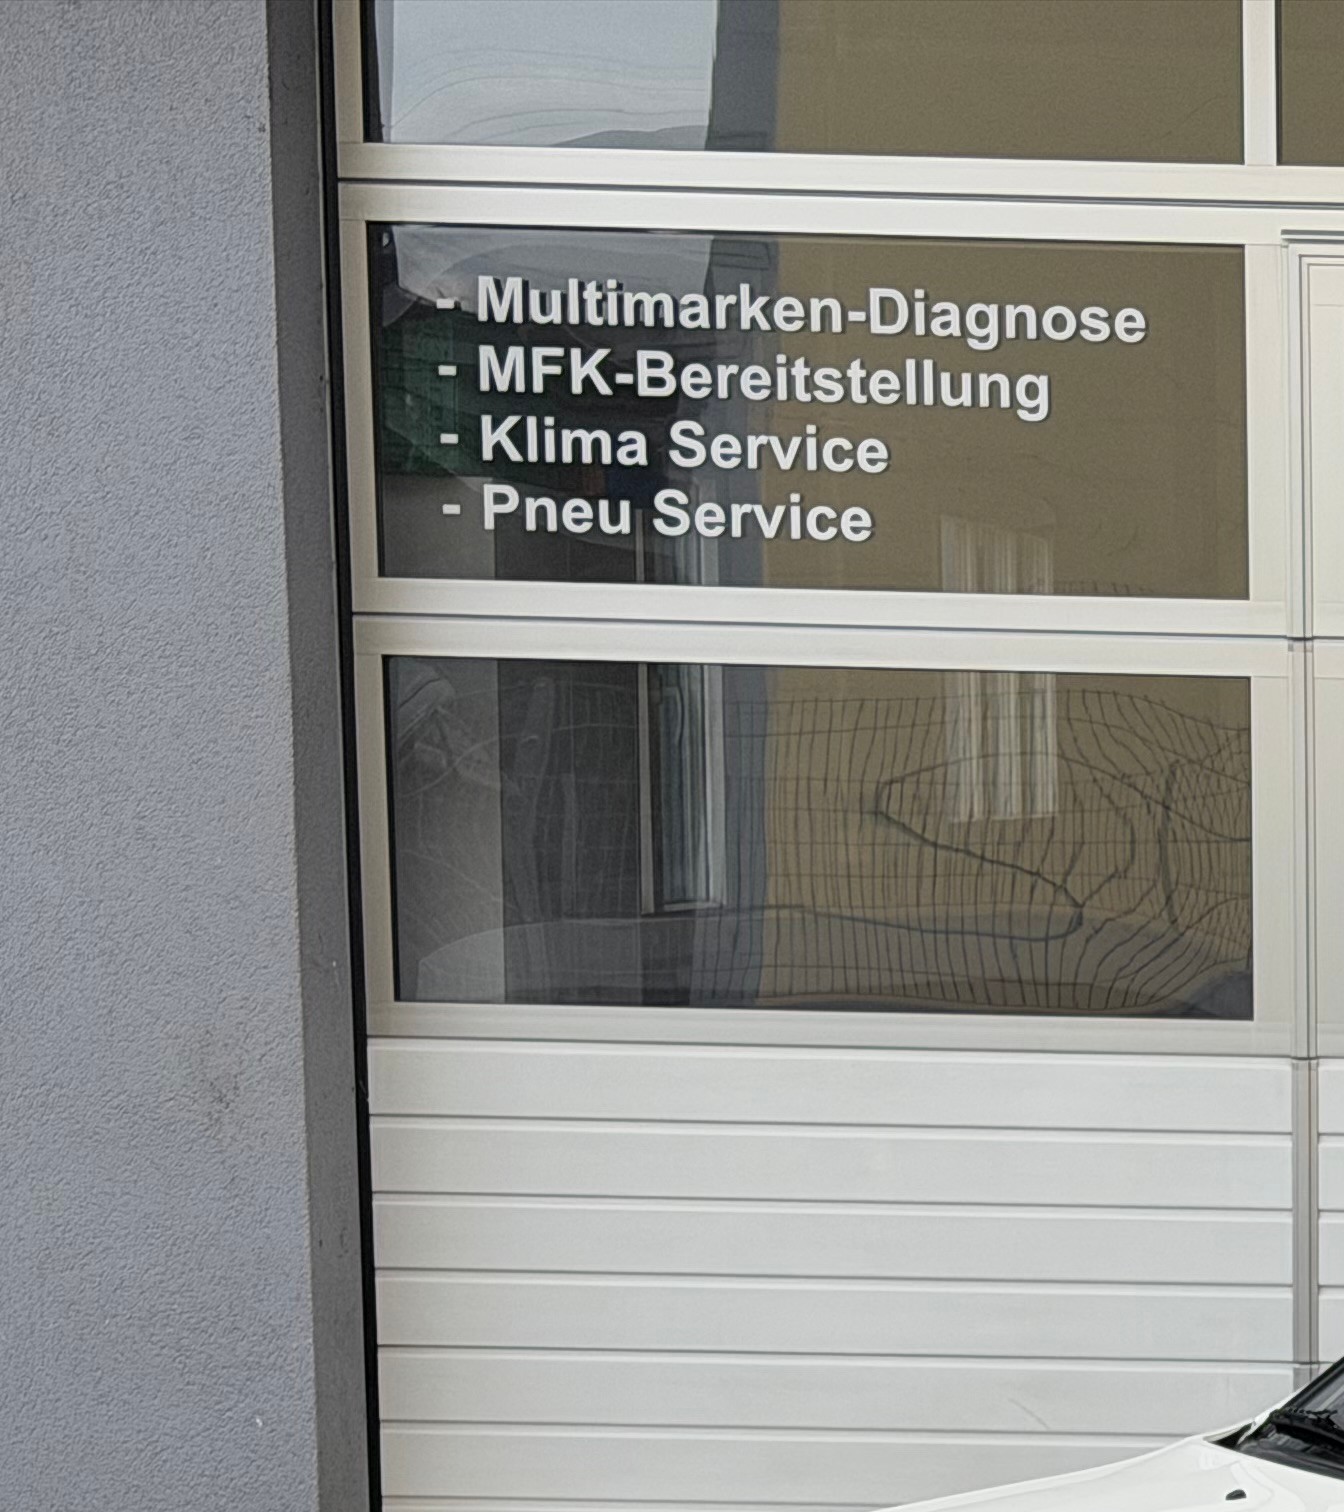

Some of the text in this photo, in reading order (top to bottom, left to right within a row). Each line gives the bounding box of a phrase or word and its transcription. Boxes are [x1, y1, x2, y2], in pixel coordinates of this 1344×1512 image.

[477, 274, 1147, 352] Multimarken-Diagnose
[478, 344, 1050, 423] MFK-Bereitstellung
[480, 414, 648, 466] Klima
[668, 419, 889, 474] Service
[482, 483, 631, 535] Pneu
[652, 488, 873, 543] Service
